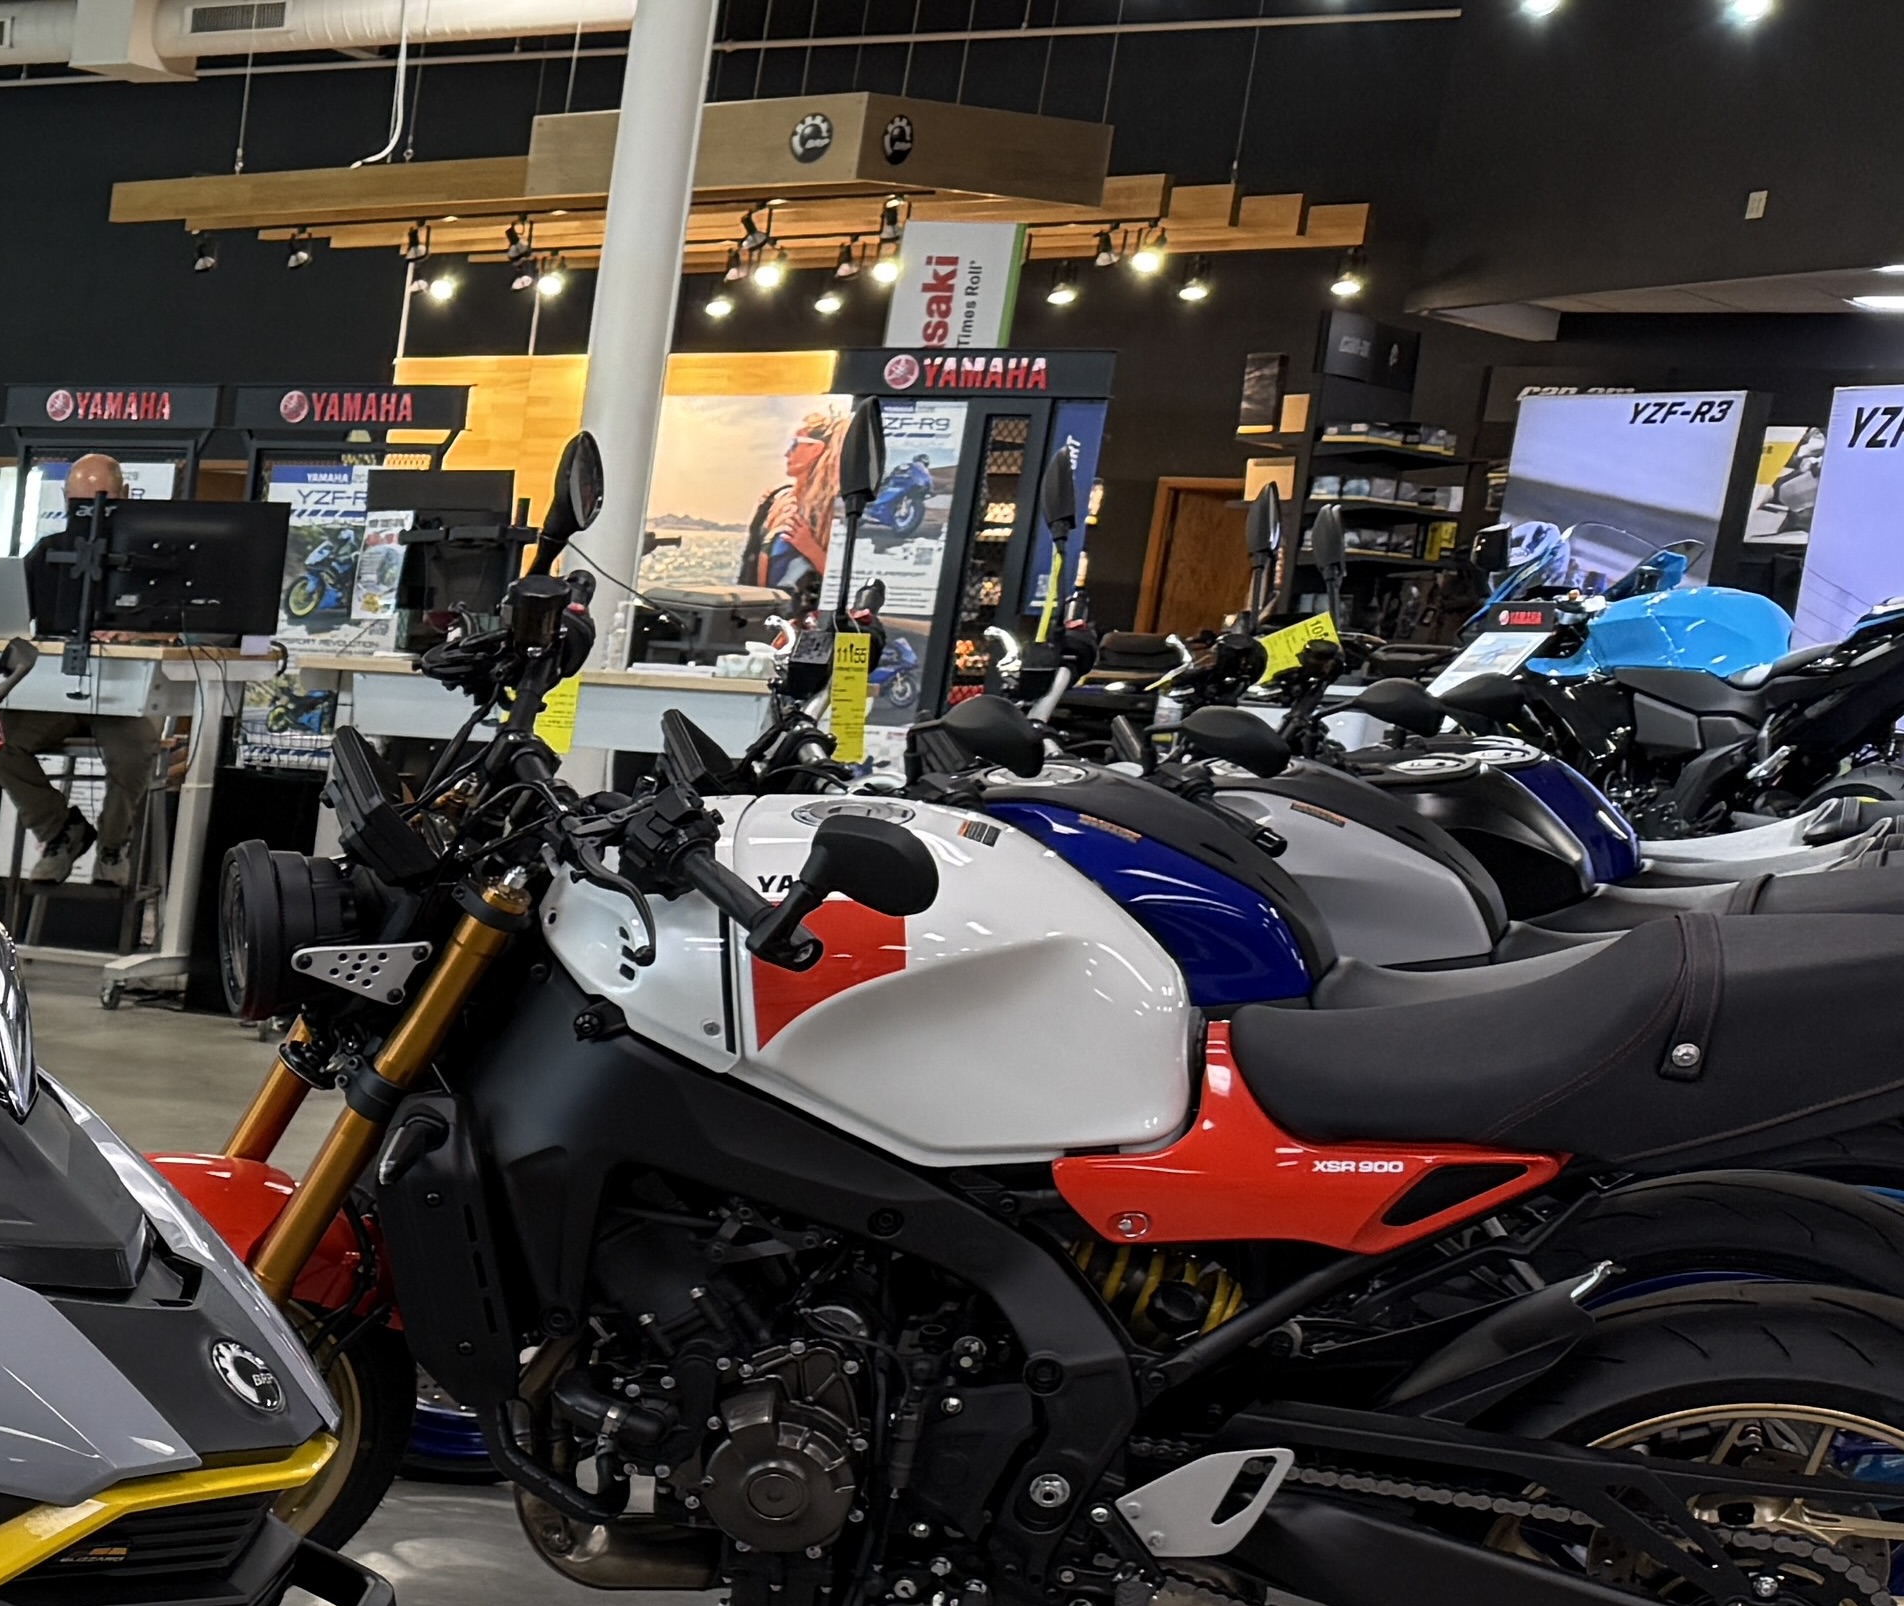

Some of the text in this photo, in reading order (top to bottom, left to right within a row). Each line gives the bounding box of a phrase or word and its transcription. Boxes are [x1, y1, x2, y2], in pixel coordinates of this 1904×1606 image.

[921, 255, 960, 348] saki
[957, 296, 978, 347] Times
[923, 357, 1048, 391] YAMAHA
[76, 392, 171, 420] YAMAHA
[312, 392, 413, 422] YAMAHA
[1628, 400, 1734, 425] YZF-R3
[884, 416, 952, 431] ZF-R9
[306, 472, 349, 483] YAMAHA
[297, 489, 368, 506] YZF-R
[75, 504, 118, 517] acr
[1312, 1160, 1404, 1173] XSR 900
